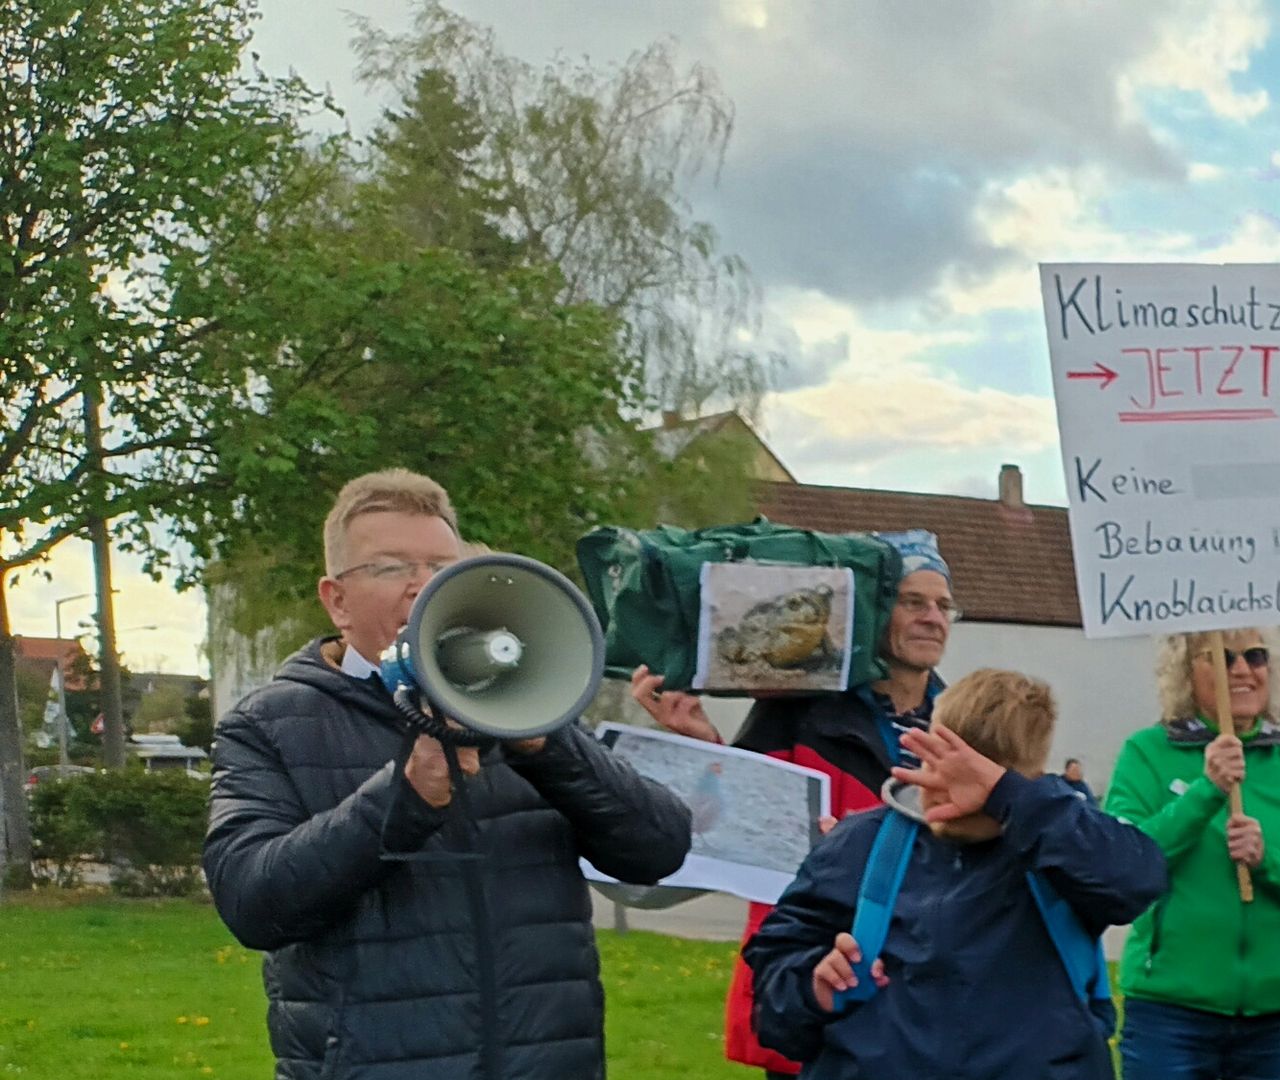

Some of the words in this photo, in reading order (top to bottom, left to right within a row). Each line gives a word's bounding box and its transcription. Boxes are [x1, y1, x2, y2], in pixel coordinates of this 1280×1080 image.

[1122, 345, 1280, 408] JETZT
[1074, 456, 1178, 502] Keine
[1095, 521, 1256, 564] Bebauung
